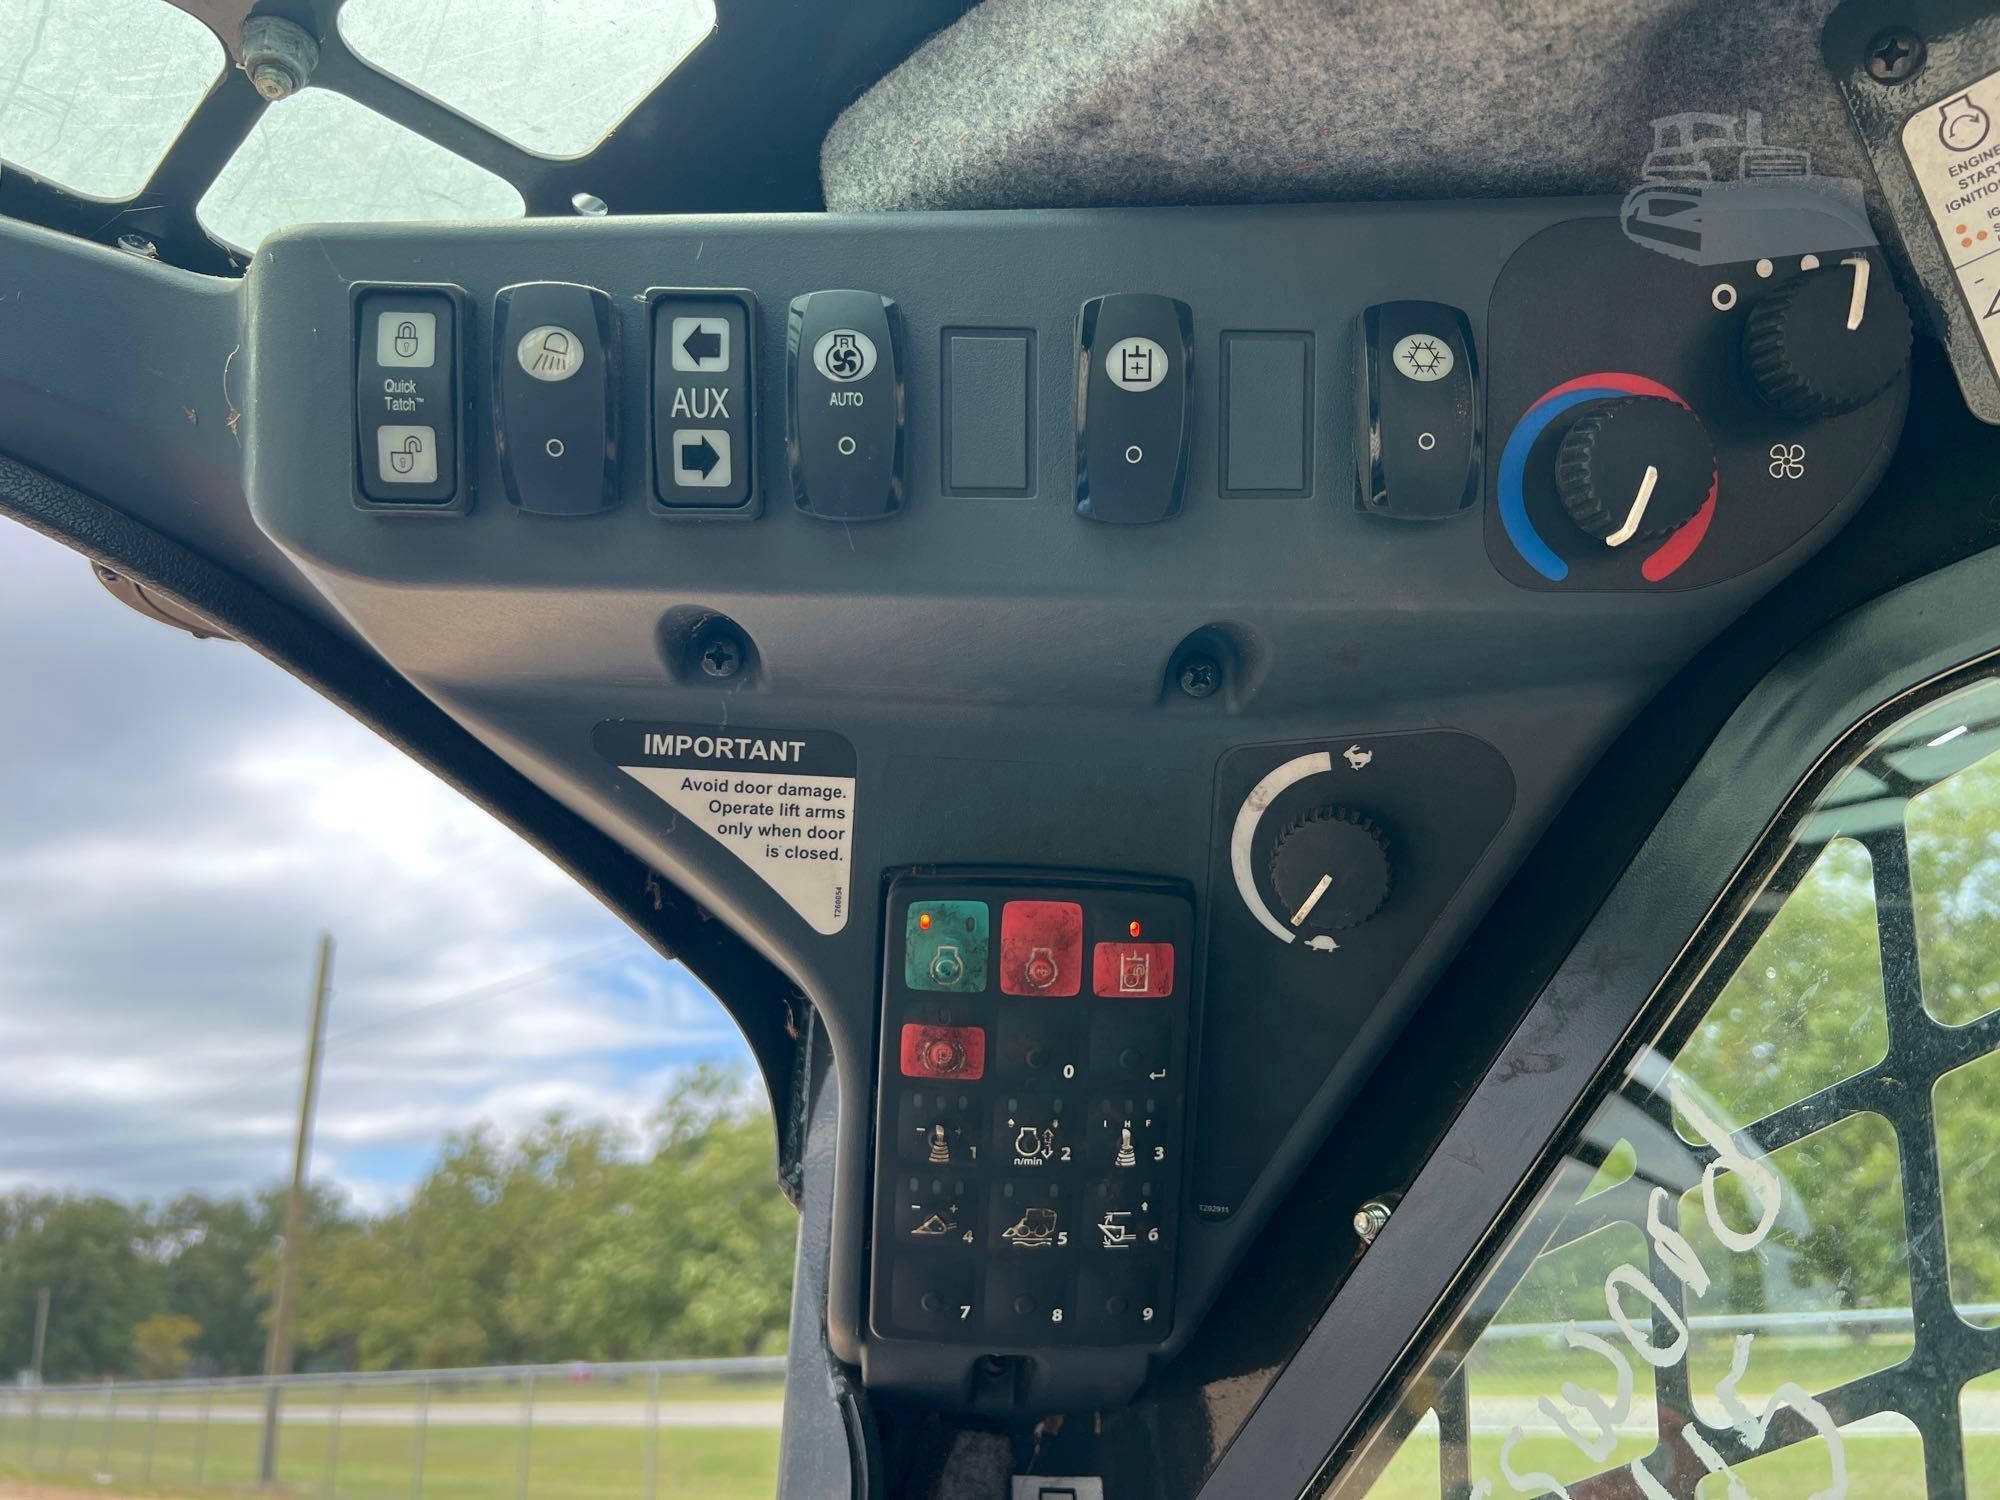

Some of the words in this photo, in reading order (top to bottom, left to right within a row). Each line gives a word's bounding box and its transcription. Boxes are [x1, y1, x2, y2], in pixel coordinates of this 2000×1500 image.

[1945, 179, 2000, 213] IGNITIO
[384, 378, 417, 393] Quick
[671, 387, 730, 419] AUX
[829, 392, 864, 407] AUTO
[643, 733, 806, 762] IMPORTANT
[680, 777, 729, 793] Avoid
[734, 779, 773, 795] door
[778, 782, 847, 800] damage.
[709, 800, 774, 817] Operate
[779, 802, 800, 817] lift
[805, 806, 846, 819] arms
[717, 823, 752, 839] only
[758, 823, 802, 838] when
[807, 825, 846, 840] door
[765, 844, 779, 858] is
[785, 846, 843, 861] closed.
[1063, 1064, 1075, 1079] 0
[1124, 1119, 1131, 1128] H
[969, 1145, 977, 1160] 1
[1060, 1146, 1072, 1161] 2
[1154, 1146, 1165, 1160] 3
[1013, 1156, 1043, 1166] n/min
[962, 1230, 974, 1244] 4
[1057, 1231, 1068, 1246] 5
[1147, 1227, 1159, 1242] 6
[960, 1305, 971, 1320] 7
[1052, 1308, 1063, 1323] 8
[1142, 1306, 1154, 1321] 9
